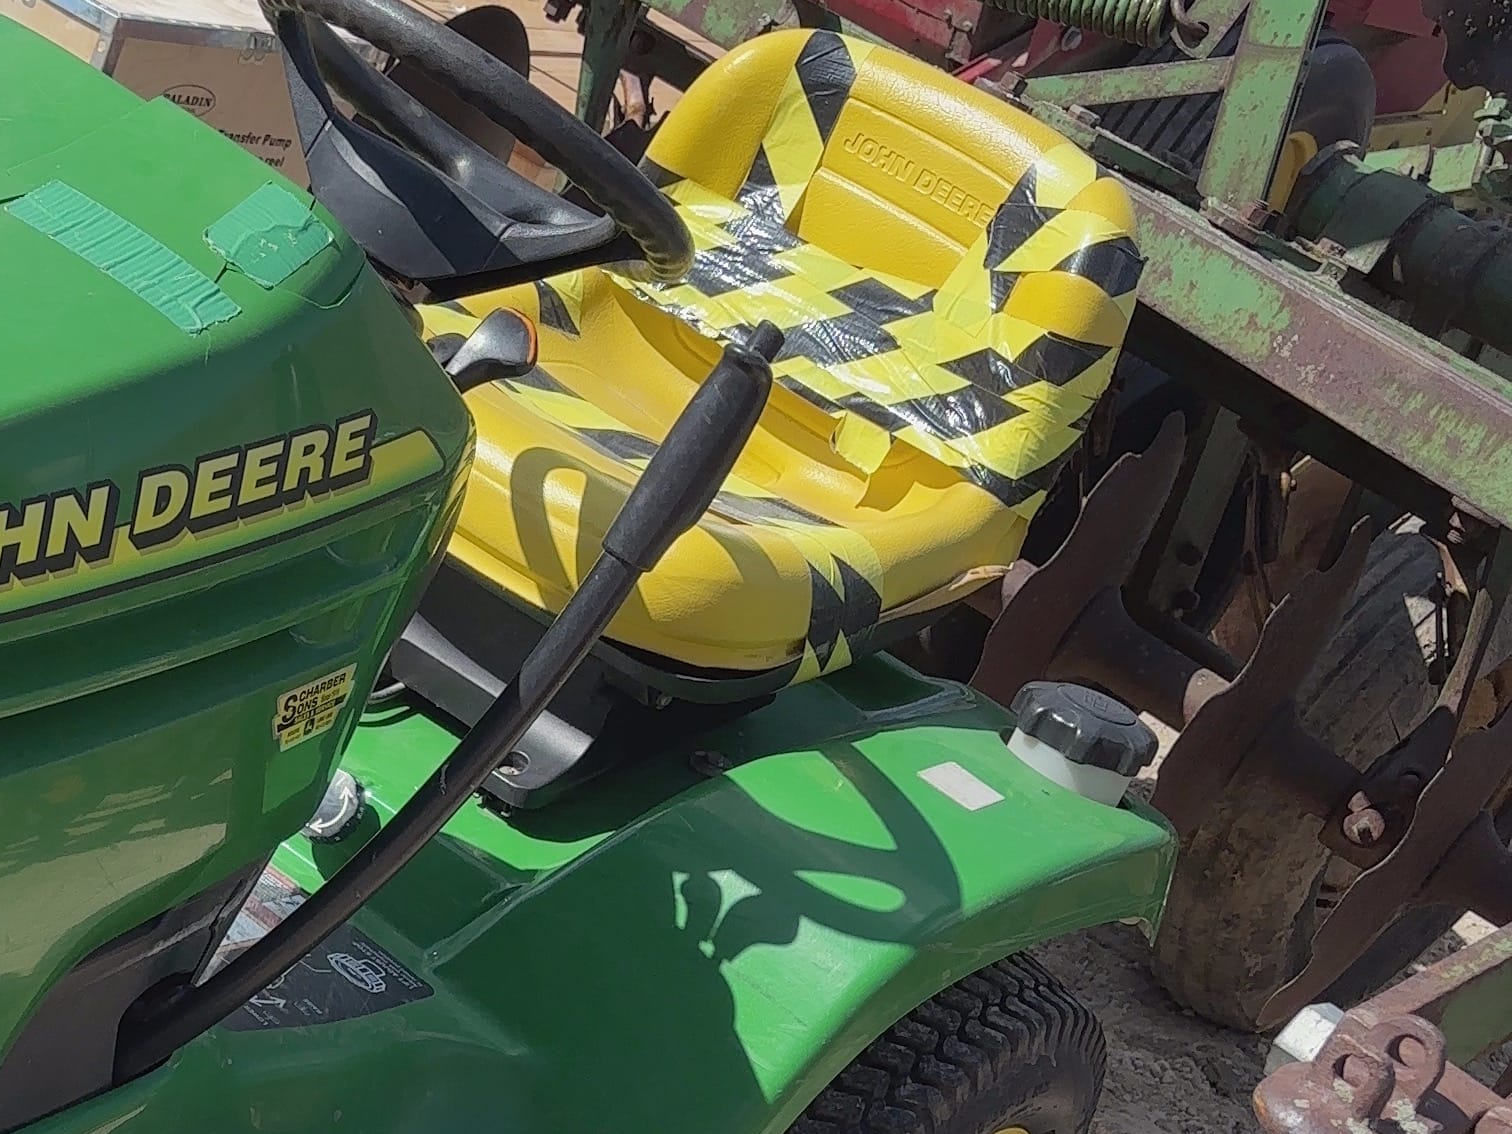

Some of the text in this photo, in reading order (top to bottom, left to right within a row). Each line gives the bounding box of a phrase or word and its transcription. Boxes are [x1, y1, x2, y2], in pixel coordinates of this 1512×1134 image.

[219, 129, 292, 151] ansfer Pump
[844, 132, 995, 229] JOHN DEERE
[131, 411, 376, 545] DEERE
